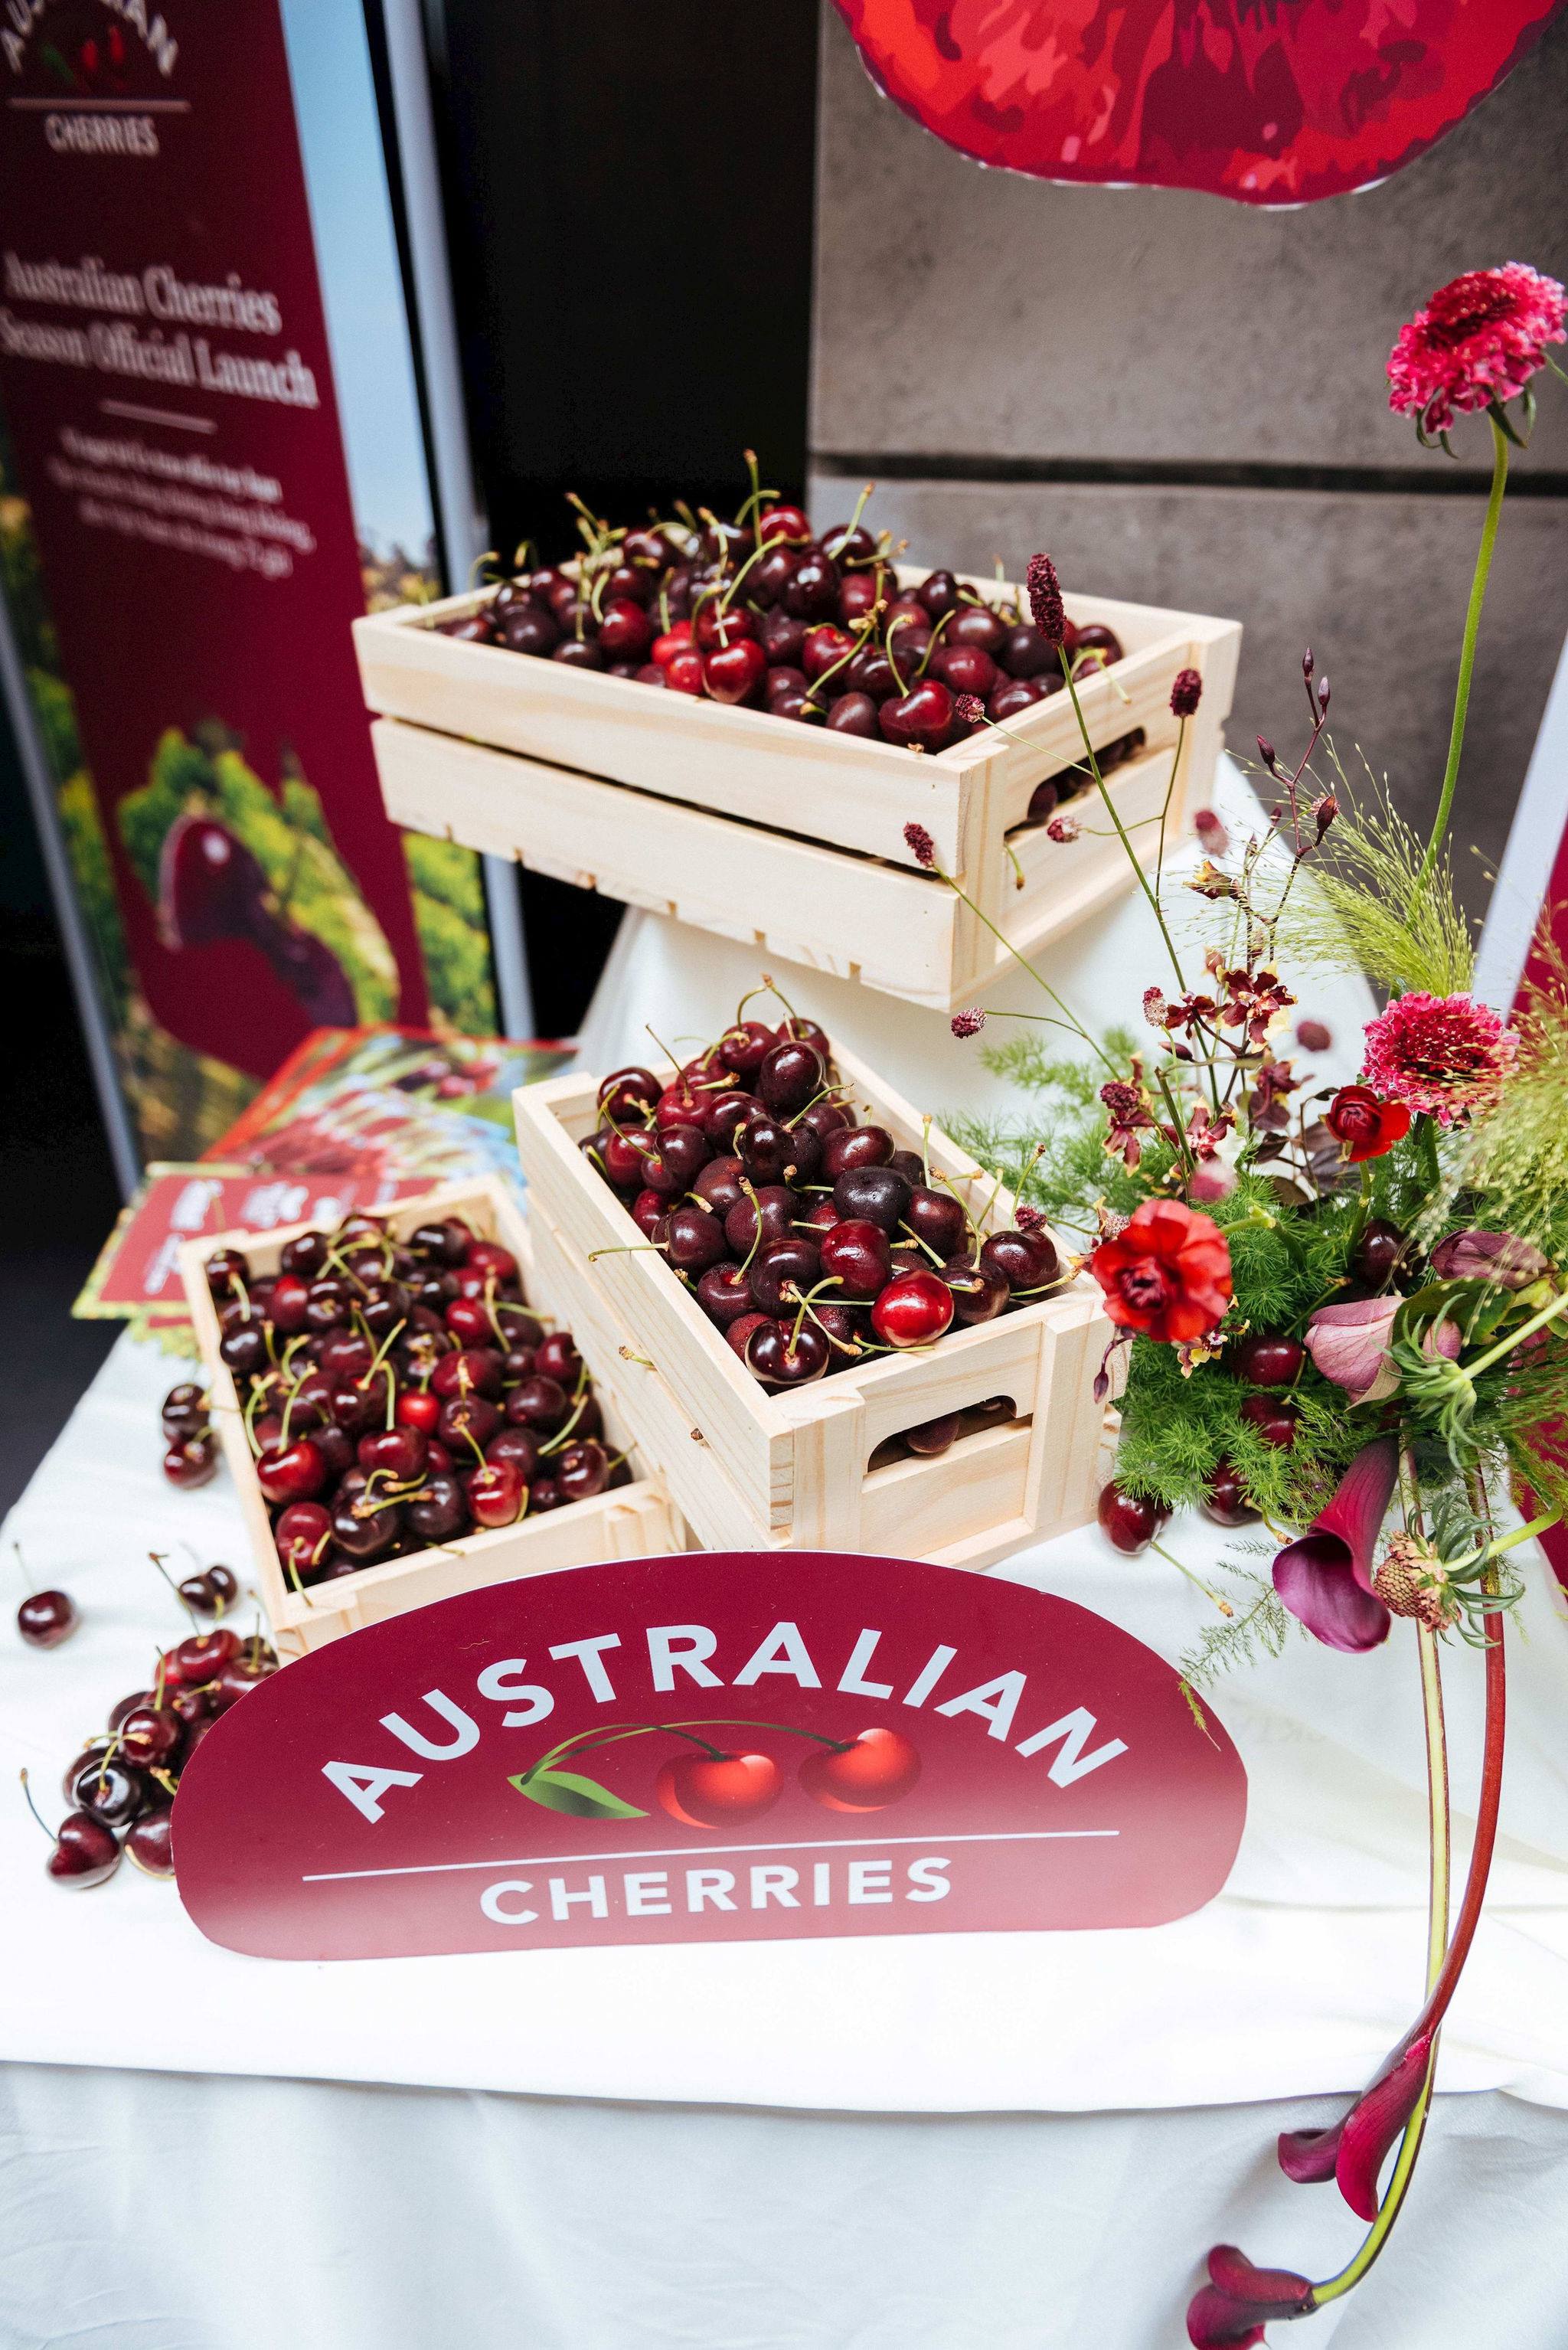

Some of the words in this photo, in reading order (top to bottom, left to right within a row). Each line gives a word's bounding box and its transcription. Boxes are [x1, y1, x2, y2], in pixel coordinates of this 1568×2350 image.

[44, 115, 159, 156] CHERRIES
[5, 251, 144, 315] Australian
[142, 264, 282, 335] Cherries
[0, 309, 91, 368] Season
[88, 322, 198, 387] Official
[194, 337, 320, 409] Launch
[322, 1621, 1129, 1824] AUSTRALIAN
[480, 1857, 952, 1925] CHERRIES
